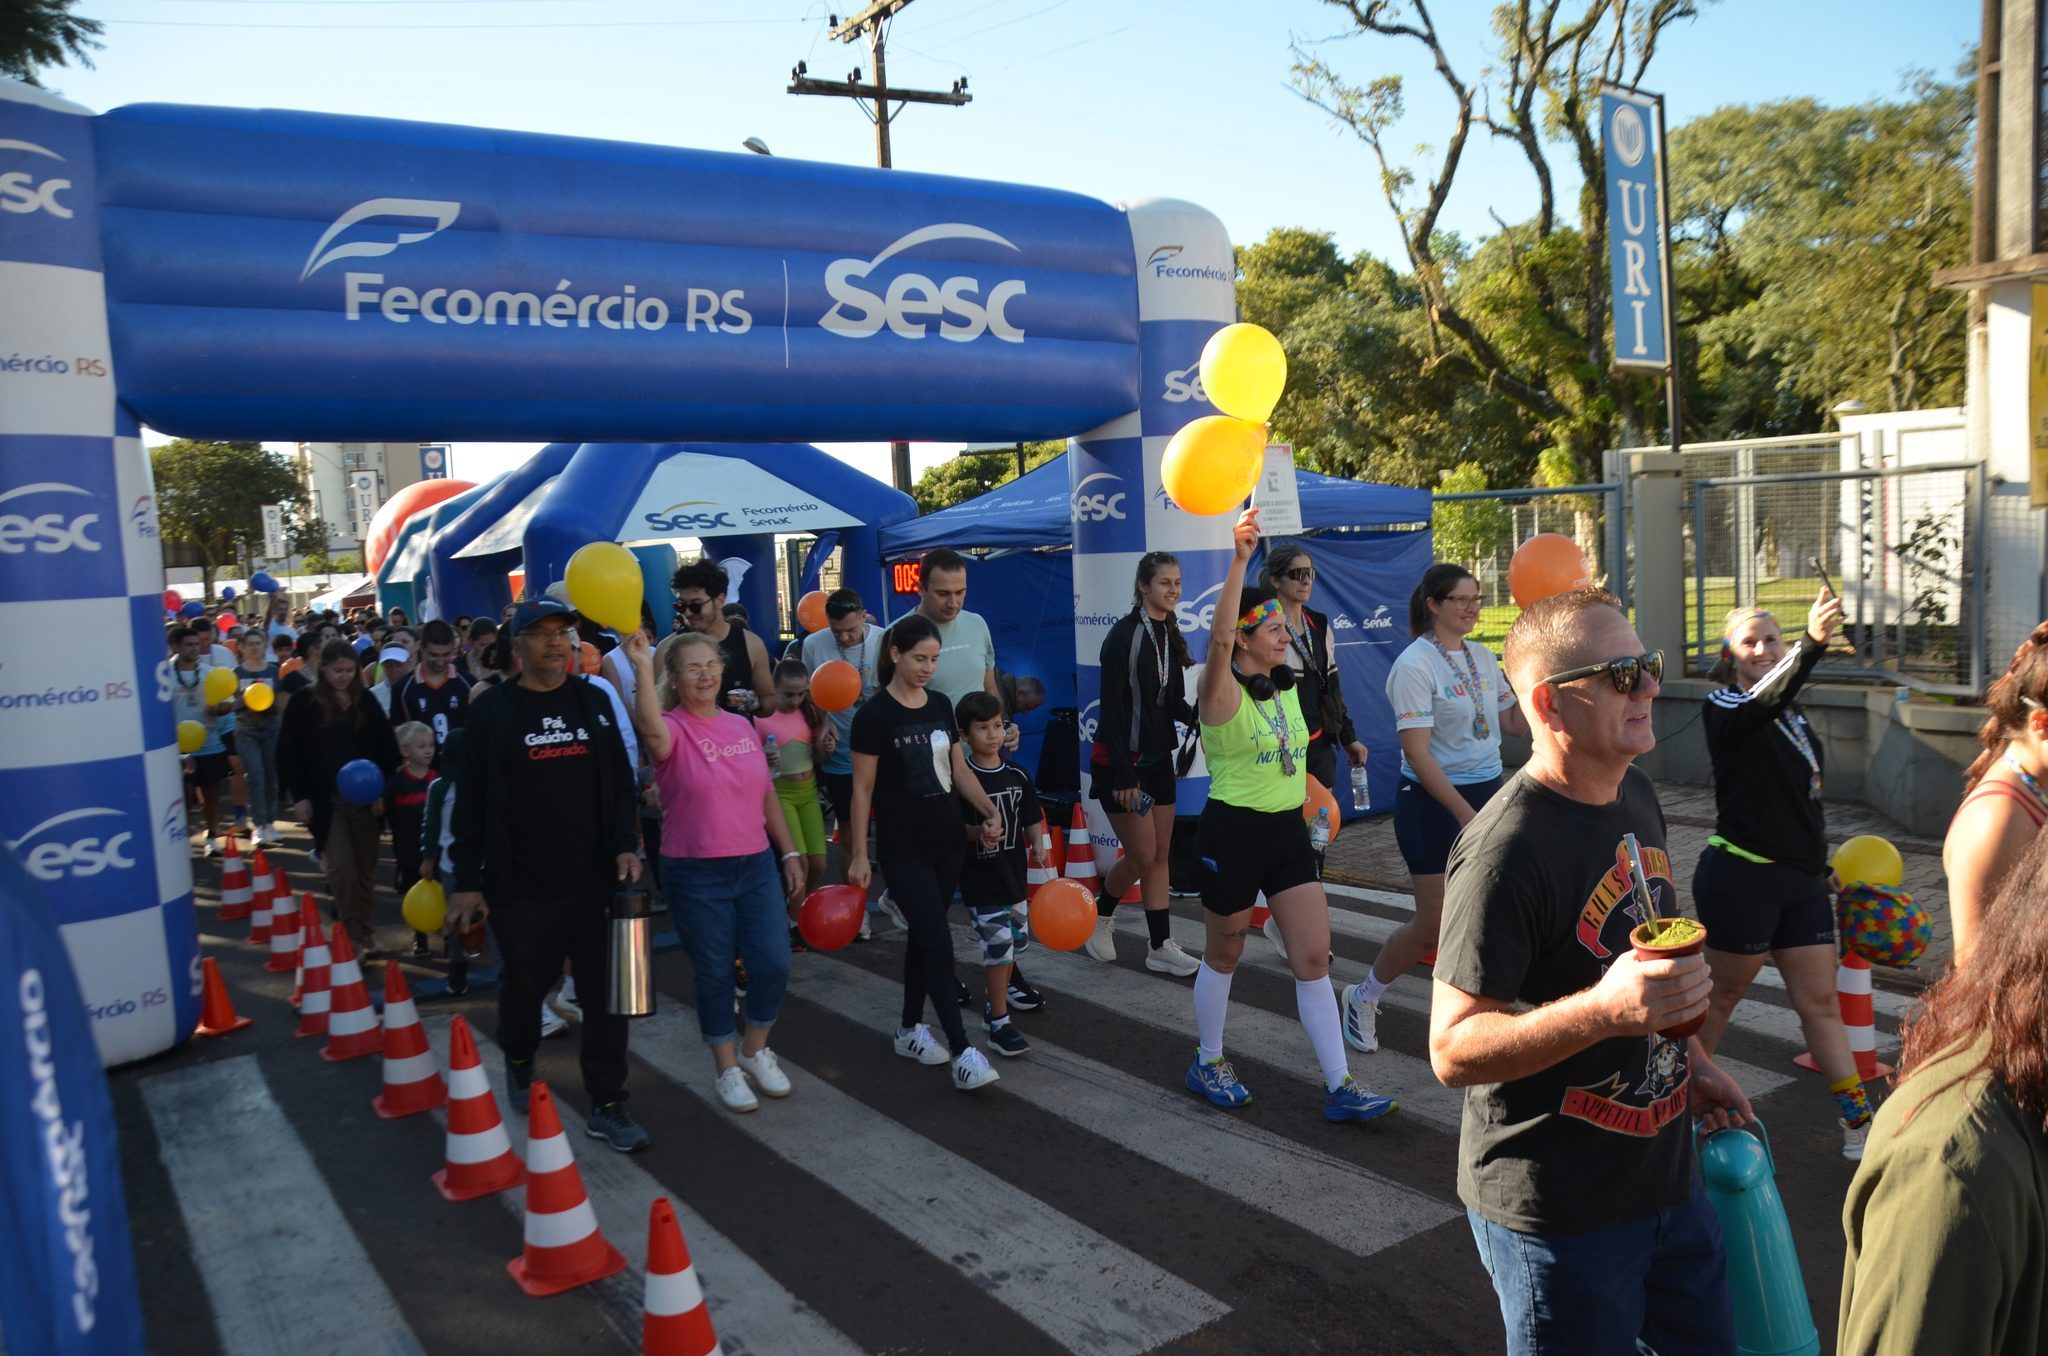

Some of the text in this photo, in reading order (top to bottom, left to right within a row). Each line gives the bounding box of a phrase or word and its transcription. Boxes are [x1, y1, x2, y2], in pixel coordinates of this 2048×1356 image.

[1156, 264, 1227, 282] Fecomércio
[1617, 178, 1652, 356] URI
[345, 272, 753, 334] Fecomércio RS
[818, 258, 1027, 343] Sesc
[75, 357, 107, 378] RS
[741, 503, 819, 517] Fecomércio
[644, 511, 737, 532] Sesc
[105, 682, 133, 700] RS
[577, 728, 589, 741] &
[141, 987, 169, 1010] RS
